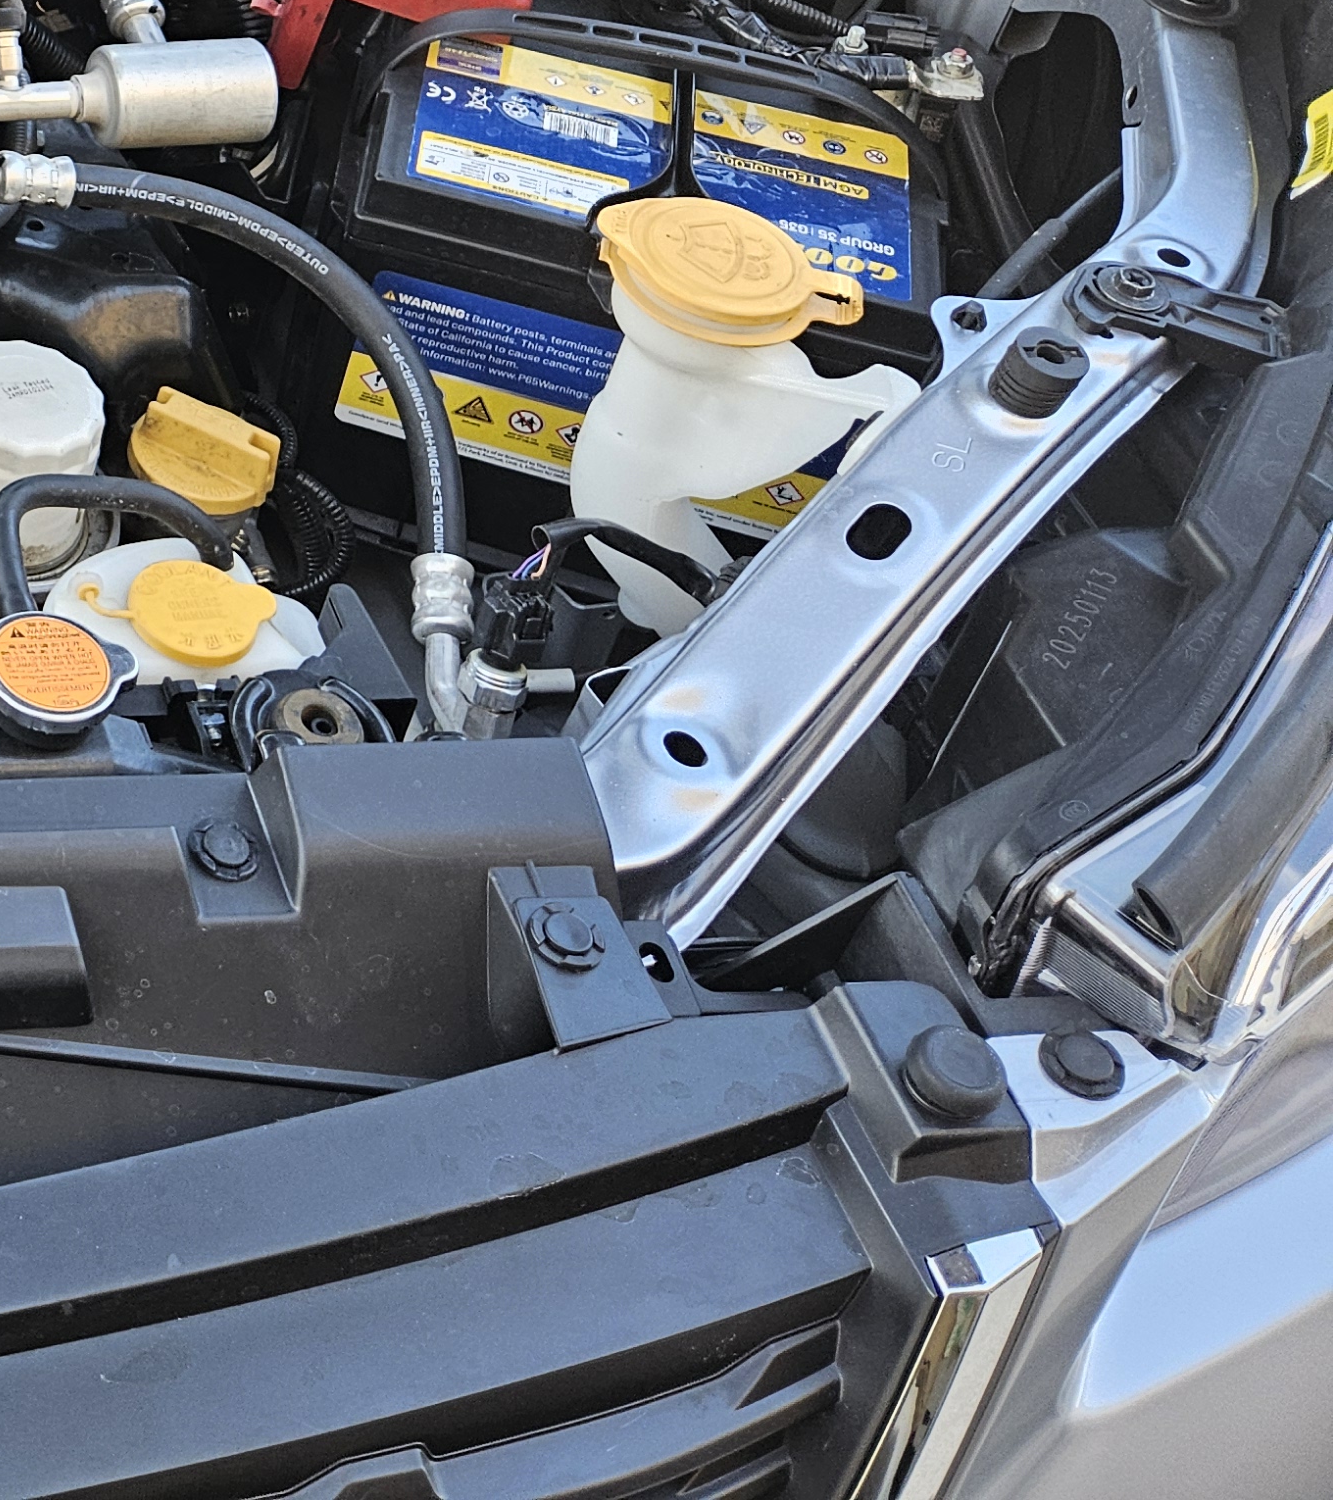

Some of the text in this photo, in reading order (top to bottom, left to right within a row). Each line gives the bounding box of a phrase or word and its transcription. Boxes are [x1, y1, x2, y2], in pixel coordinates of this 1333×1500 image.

[715, 154, 863, 196] AGM TECHNOLOGY
[778, 219, 895, 256] GROUP 35 G35
[398, 292, 471, 321] WARNING:
[471, 314, 513, 333] Battery
[550, 334, 604, 355] terminals
[405, 307, 425, 320] and
[427, 313, 451, 328] lead
[451, 321, 517, 346] compounds.
[520, 338, 545, 353] This
[545, 346, 590, 366] Product
[416, 335, 487, 361] reproductive
[487, 354, 519, 370] harm.
[419, 347, 485, 372] information:
[427, 325, 441, 337] of
[441, 329, 492, 350] California
[495, 343, 506, 353] to
[507, 347, 540, 363] cause
[932, 437, 973, 474] SL
[1041, 565, 1117, 671] 20250113
